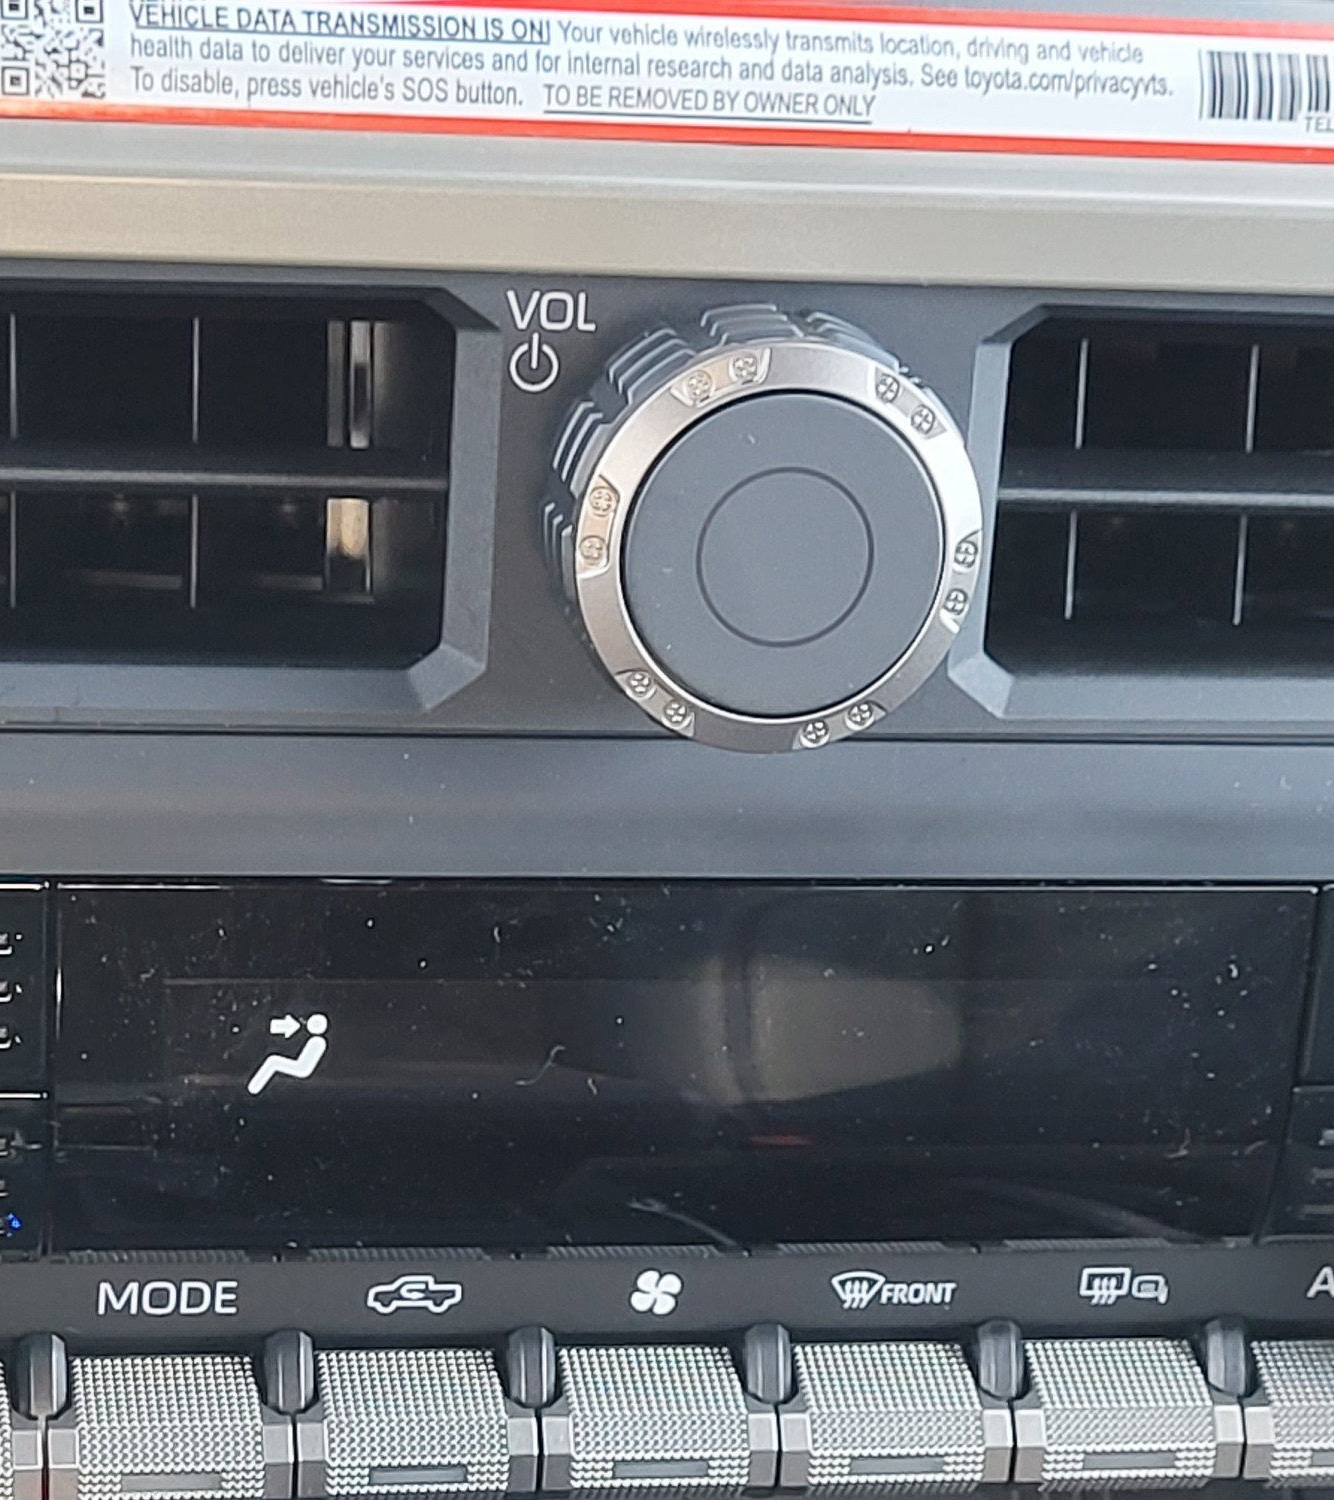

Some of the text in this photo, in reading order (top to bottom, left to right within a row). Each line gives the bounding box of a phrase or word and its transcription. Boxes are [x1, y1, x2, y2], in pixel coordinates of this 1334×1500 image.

[129, 4, 229, 29] VEHICLE
[237, 8, 296, 32] DATA
[303, 11, 476, 40] TRANSMISSION
[485, 18, 504, 41] IS
[558, 20, 602, 44] Your
[609, 23, 678, 47] vehicle
[685, 26, 779, 56] wirelessly
[786, 30, 874, 54] transmits
[880, 31, 960, 59] location,
[967, 35, 1029, 64] driving
[1037, 39, 1071, 62] and
[1079, 41, 1144, 64] vehicle
[130, 33, 192, 61] health
[200, 36, 243, 62] data
[252, 39, 270, 63] to
[279, 40, 345, 66] deliver
[352, 47, 395, 71] your
[403, 46, 484, 70] services
[492, 50, 528, 73] and
[535, 50, 560, 74] for
[568, 51, 640, 77] internal
[647, 54, 732, 80] research
[739, 58, 774, 82] and
[781, 58, 822, 83] data
[830, 60, 913, 91] analysis.
[921, 63, 958, 88] See
[130, 66, 877, 118] To disable, press vehicle's SOS button. TO BE REMOVED BY OWNER ONLY
[505, 288, 597, 333] VOL
[96, 1280, 239, 1316] MODE
[879, 1281, 958, 1305] FRONT
